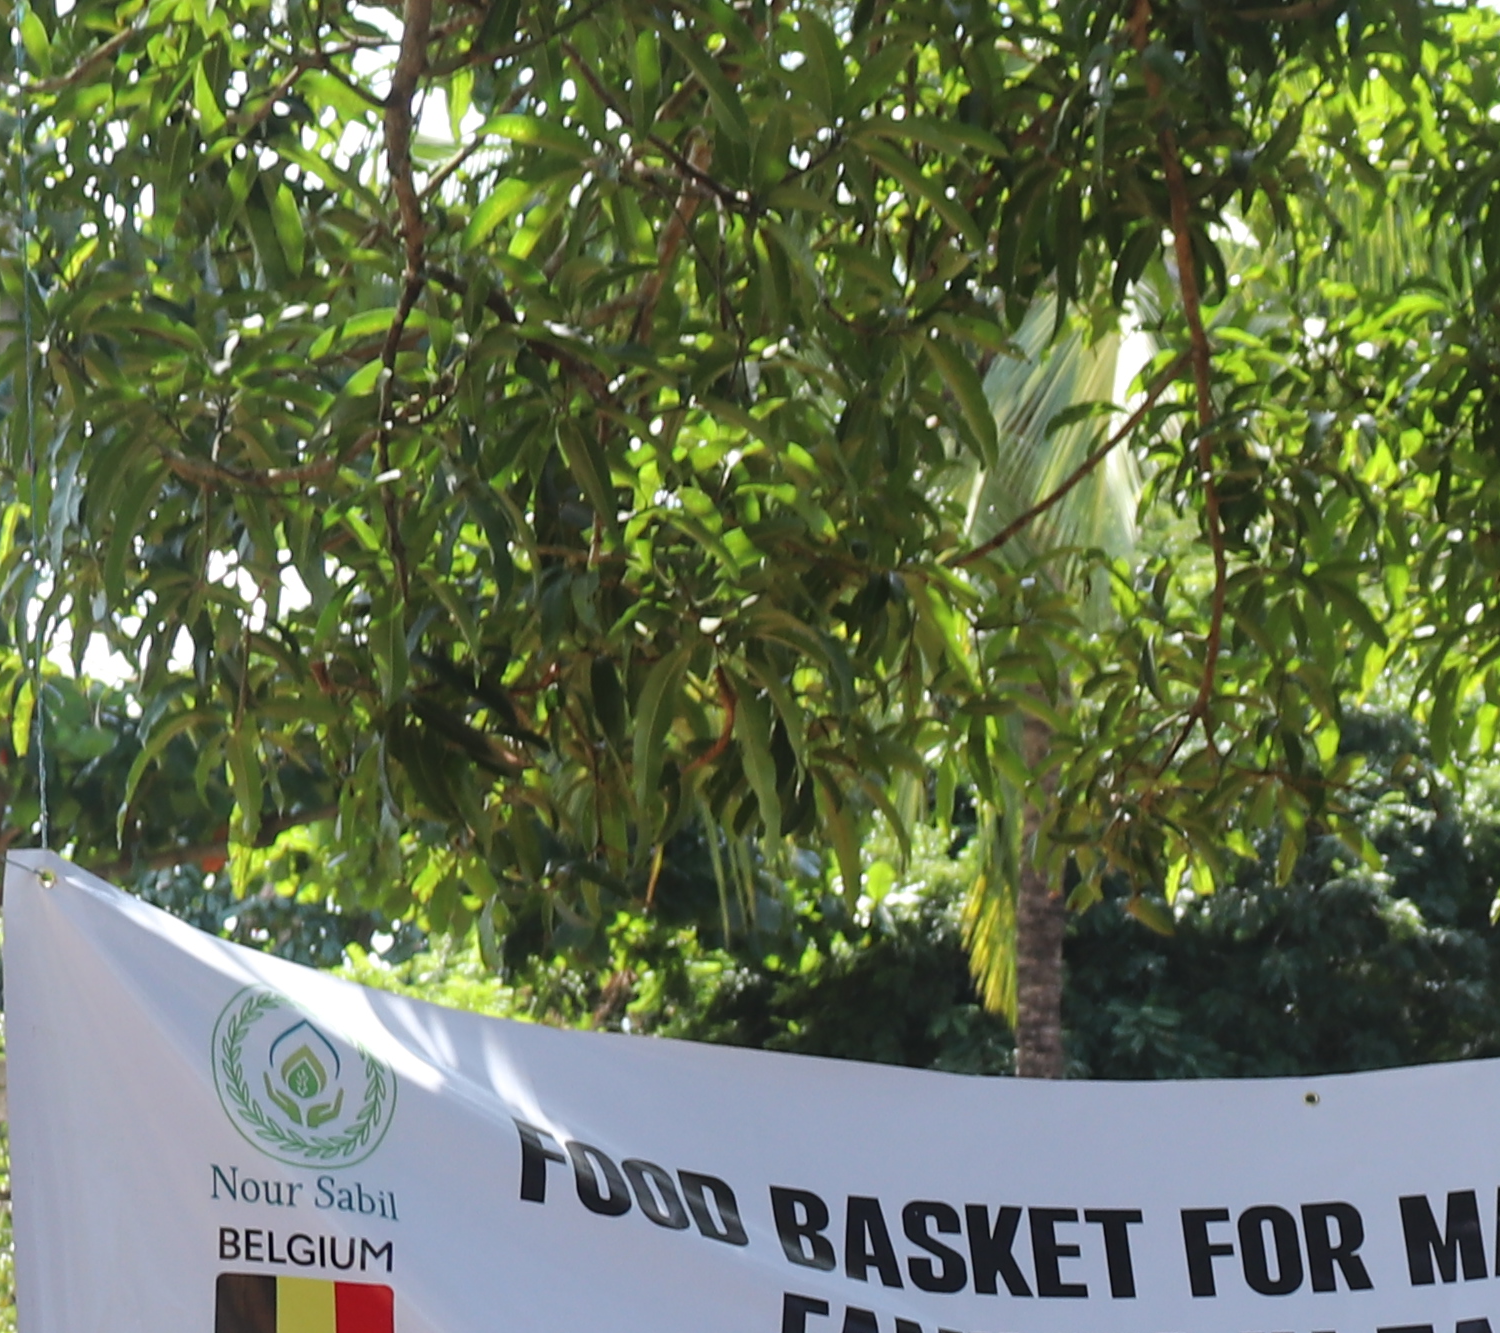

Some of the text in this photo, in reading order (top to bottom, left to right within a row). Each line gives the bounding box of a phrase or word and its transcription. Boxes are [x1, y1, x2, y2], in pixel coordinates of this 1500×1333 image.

[210, 1163, 399, 1221] Nour Sabil
[513, 1116, 748, 1247] FOOD
[769, 1185, 1143, 1299] BASKET
[1181, 1201, 1373, 1299] FOR
[219, 1227, 393, 1272] BELGIUM
